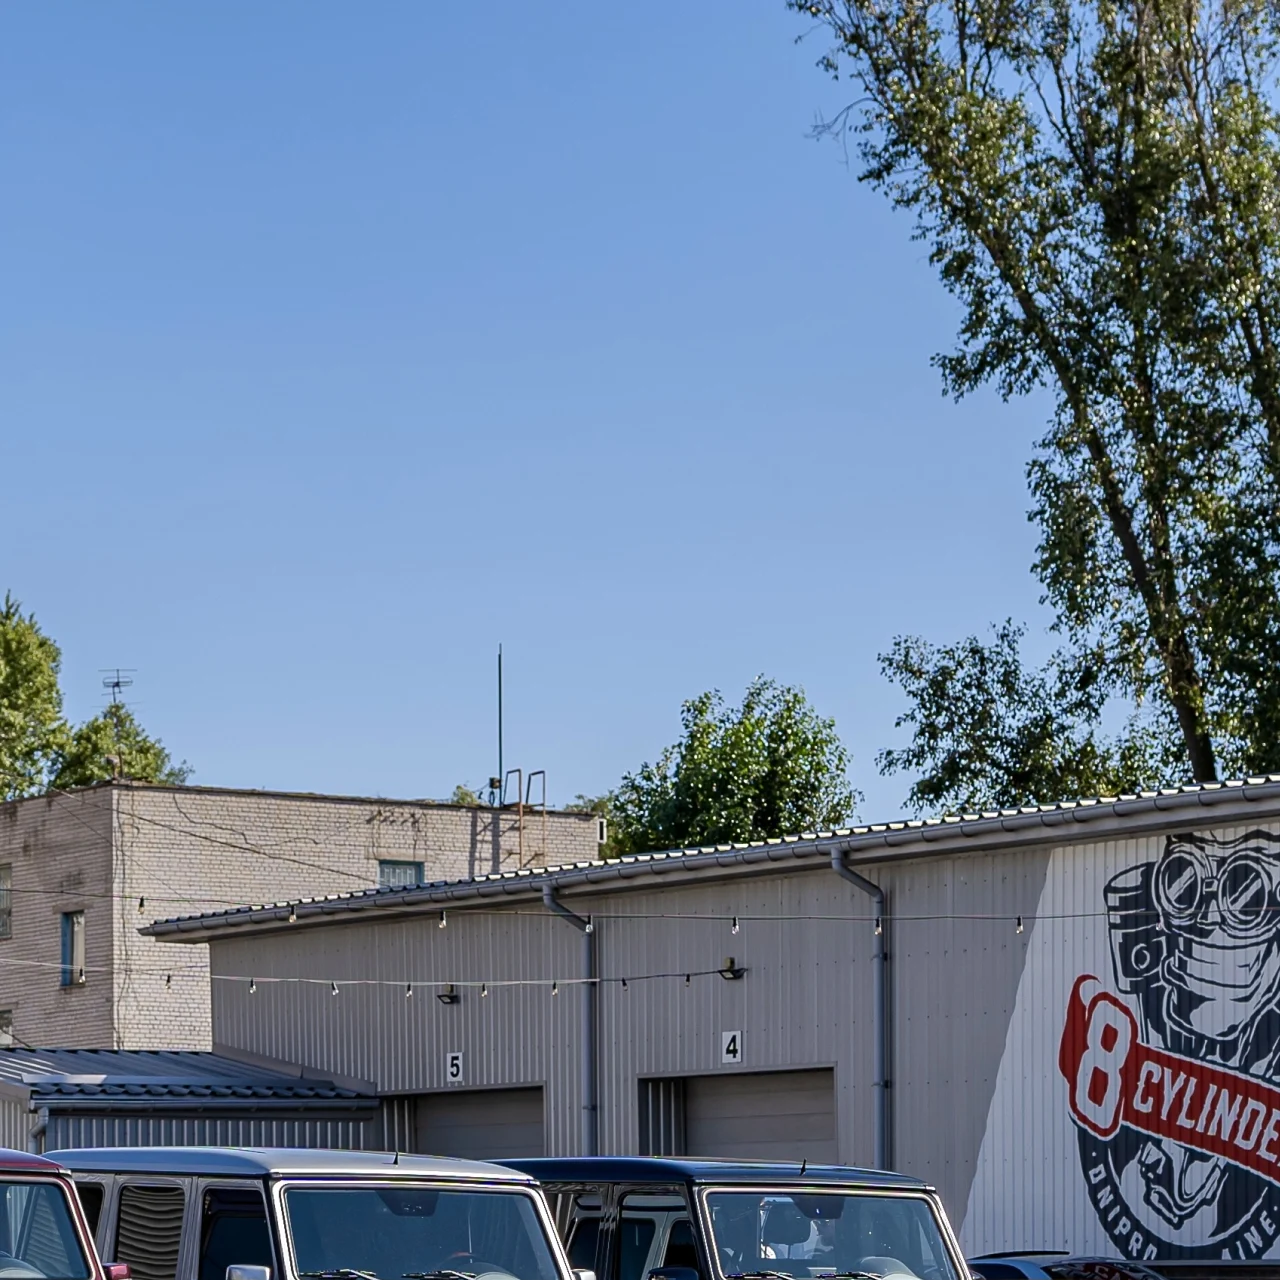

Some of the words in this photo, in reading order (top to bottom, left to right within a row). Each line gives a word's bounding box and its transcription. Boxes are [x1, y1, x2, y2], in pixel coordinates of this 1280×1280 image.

[726, 1034, 738, 1059] 4
[450, 1055, 460, 1078] 5
[1076, 999, 1132, 1130] 8
